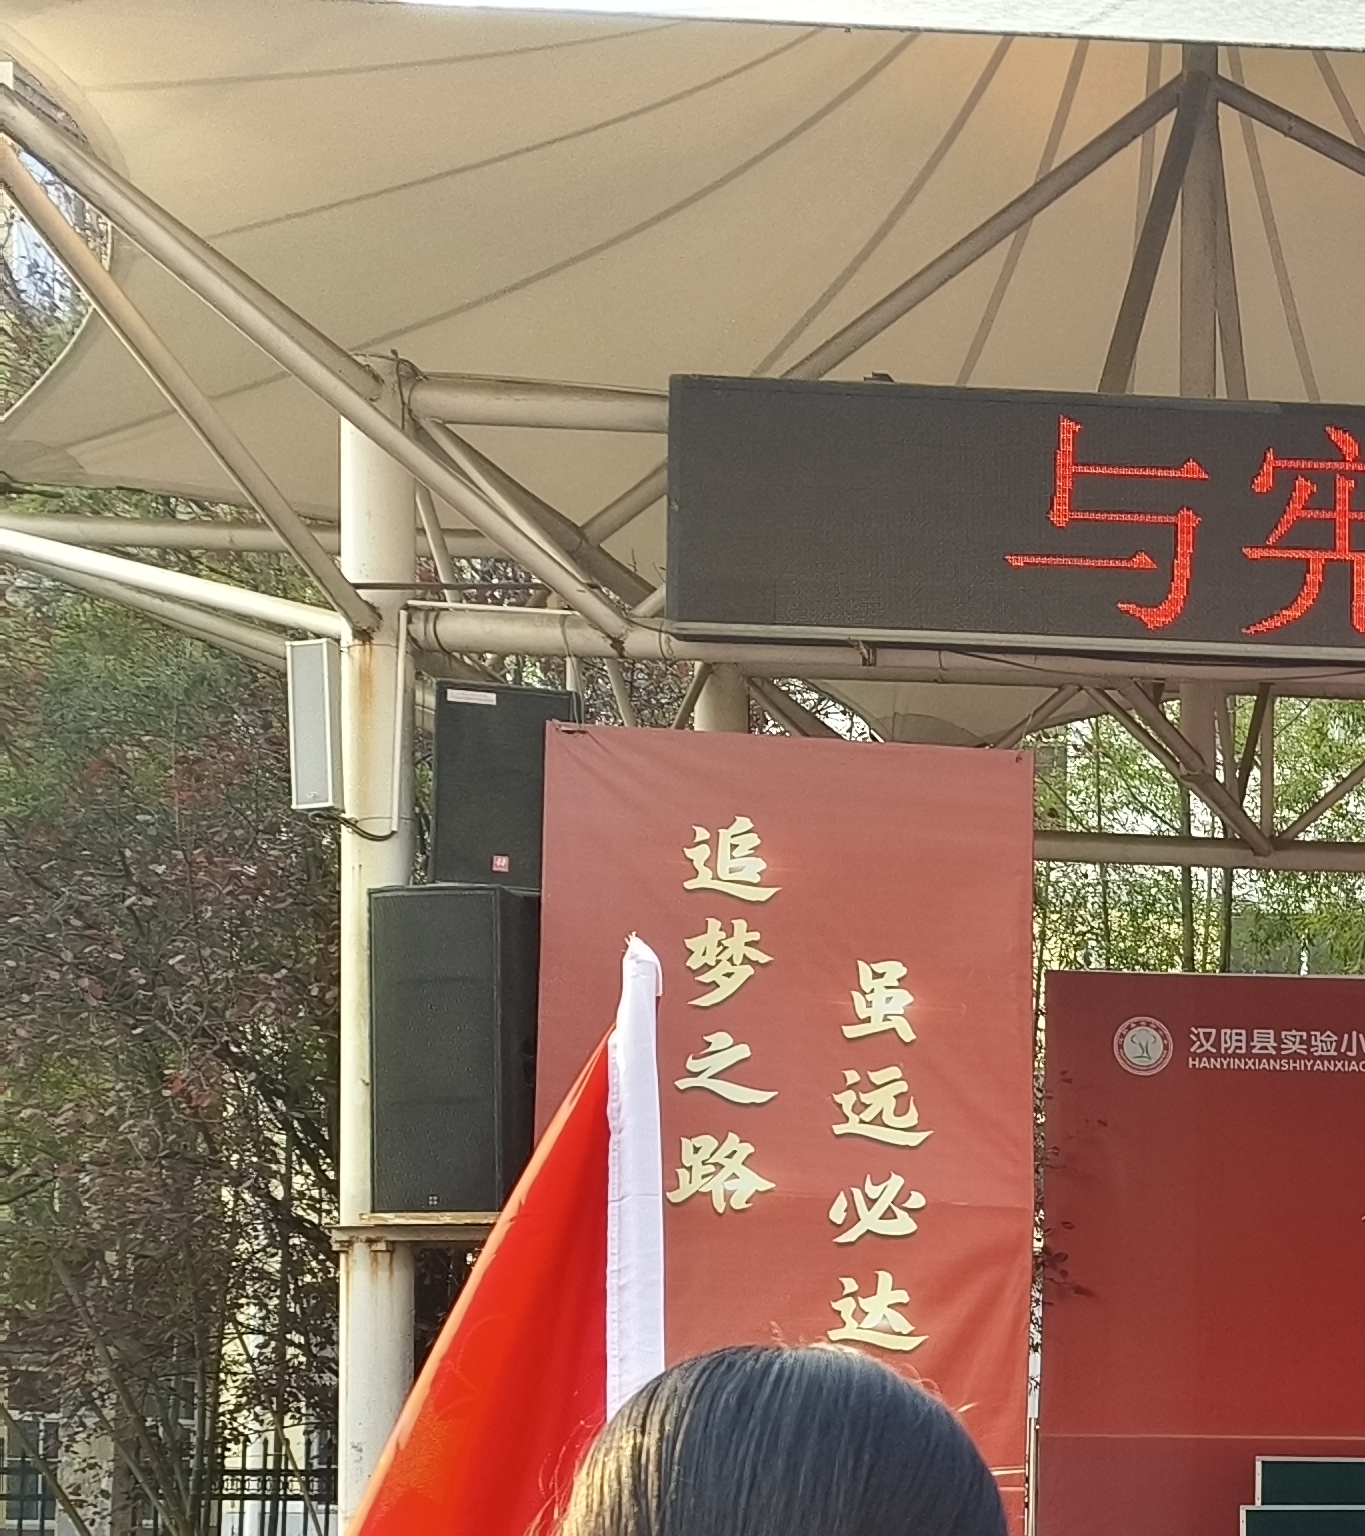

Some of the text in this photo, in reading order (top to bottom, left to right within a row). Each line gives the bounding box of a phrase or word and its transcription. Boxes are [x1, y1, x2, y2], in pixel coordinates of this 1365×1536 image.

[666, 815, 782, 1214] 追梦之路
[828, 958, 934, 1351] 虽远必达
